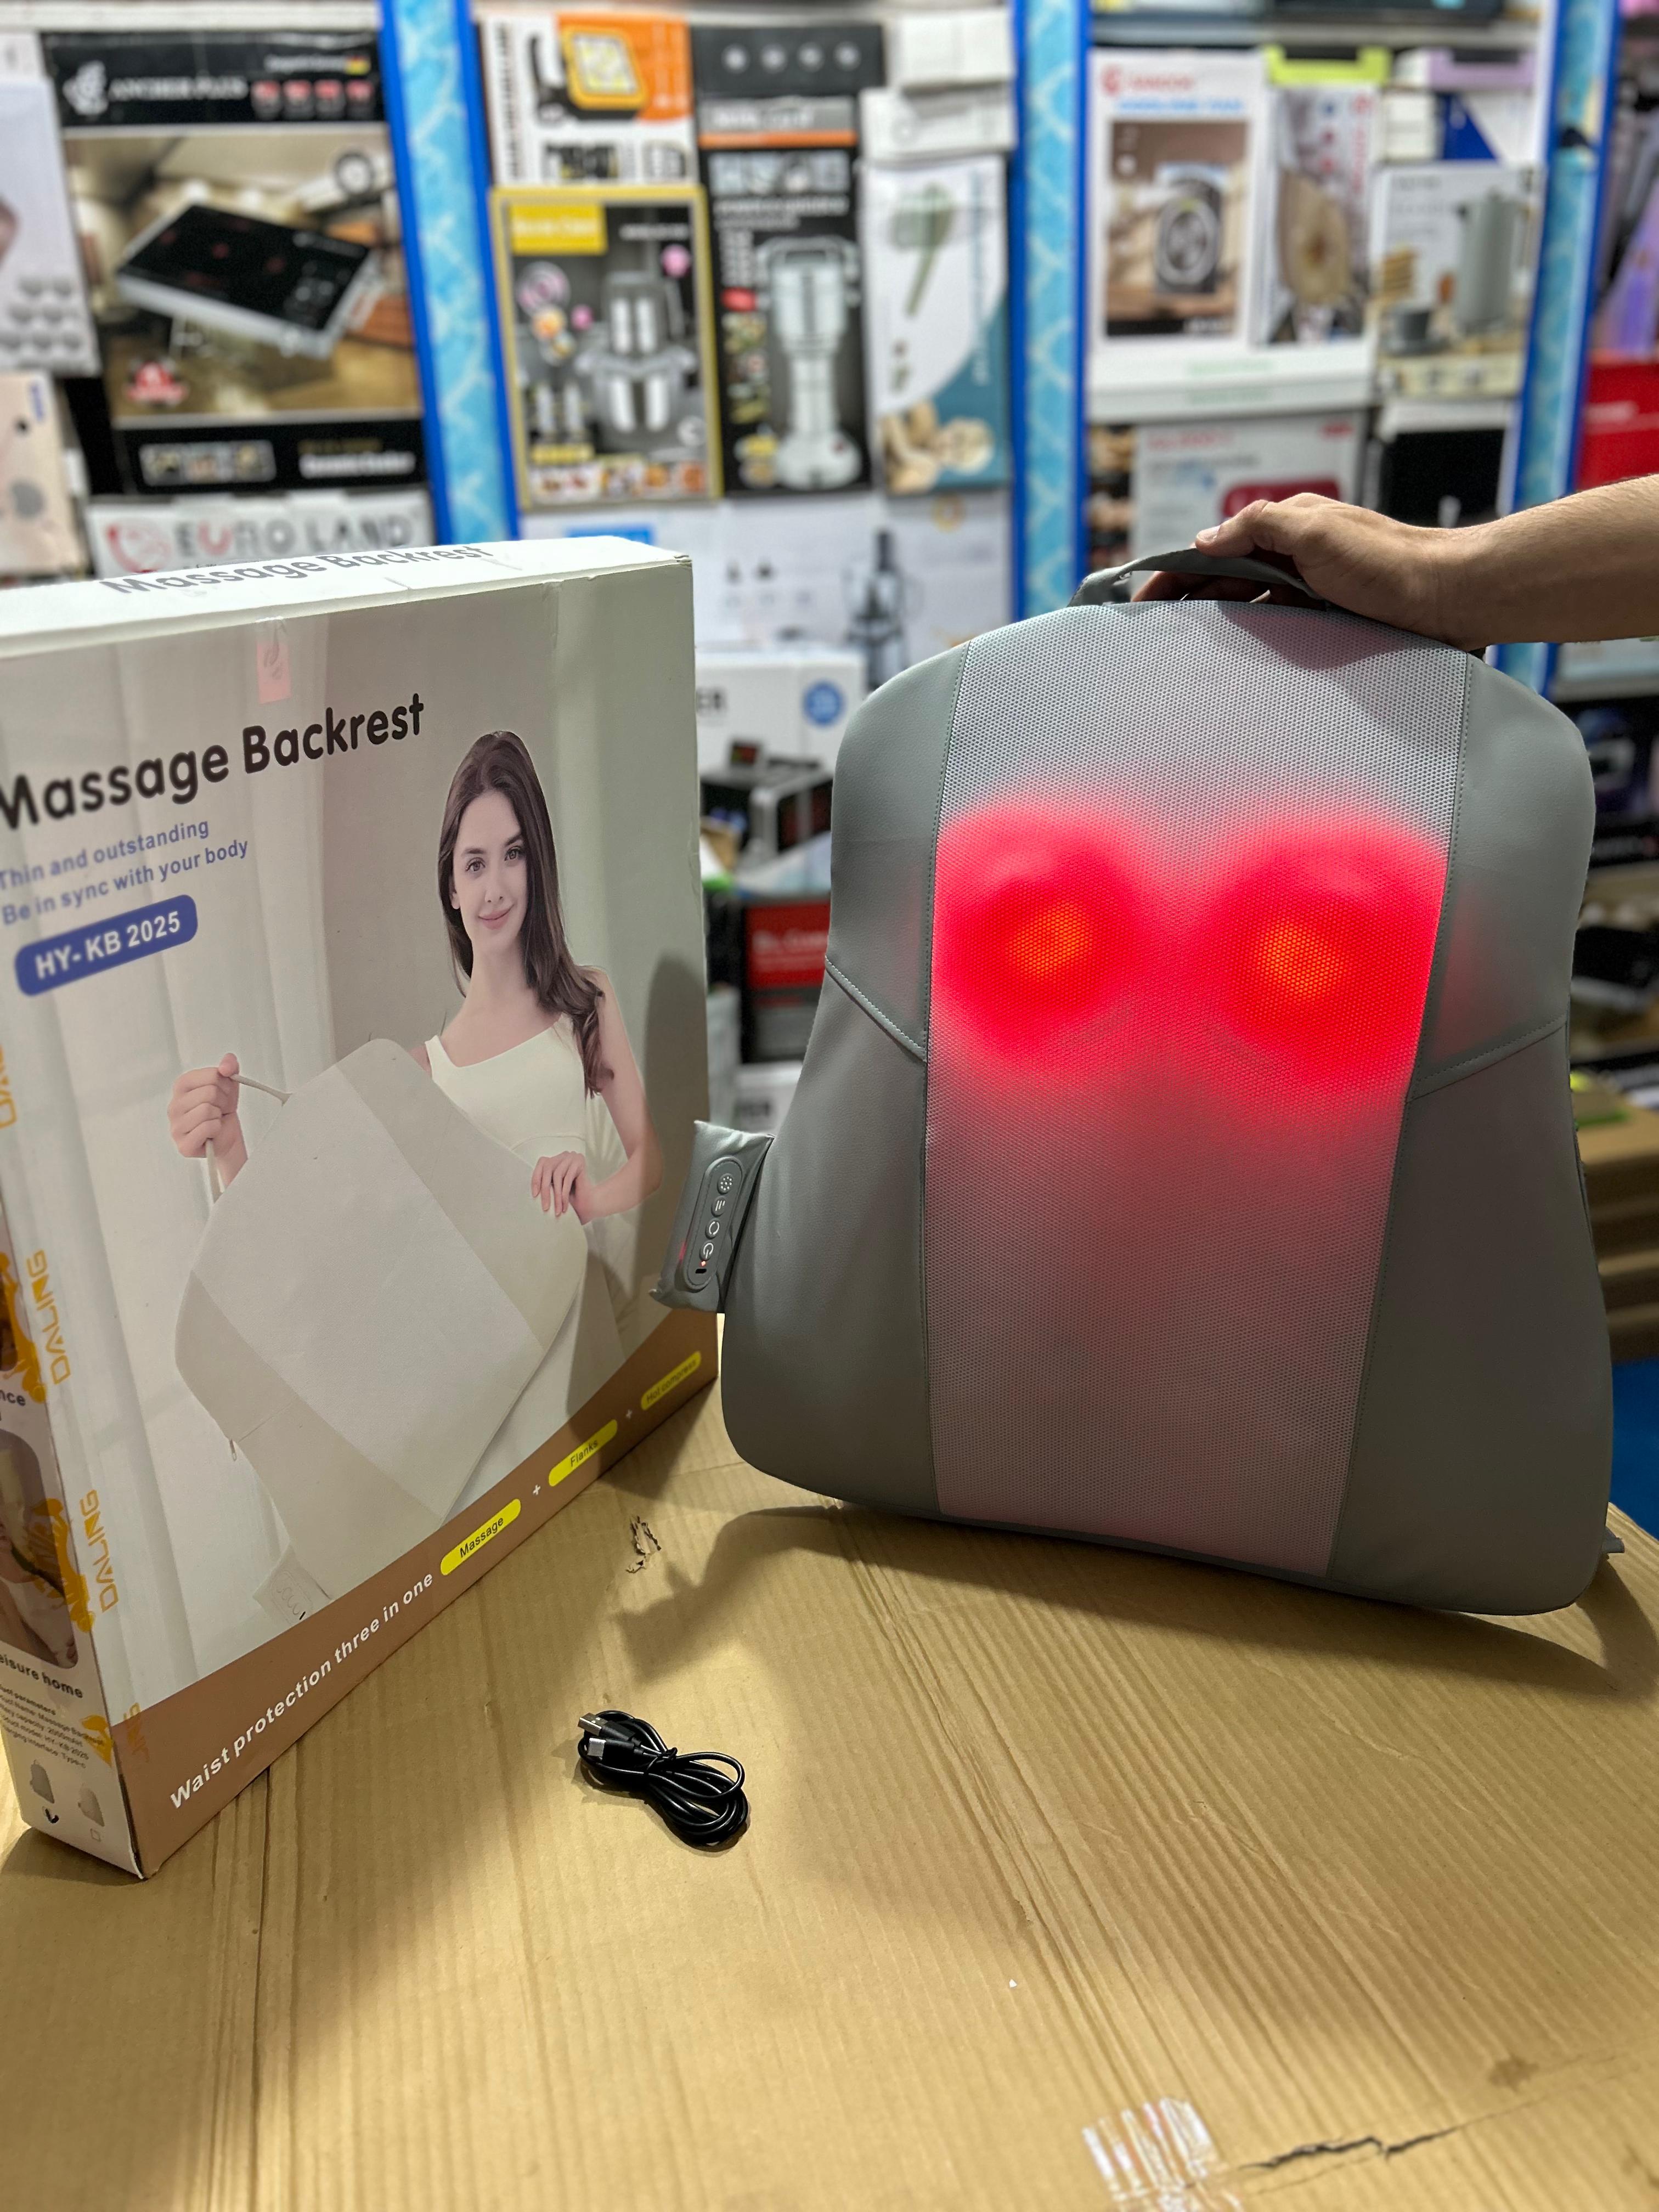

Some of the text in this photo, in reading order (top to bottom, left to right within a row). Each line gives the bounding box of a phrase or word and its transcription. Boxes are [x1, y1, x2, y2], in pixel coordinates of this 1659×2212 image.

[99, 546, 494, 594] Massage Backrest
[0, 693, 424, 830] Massage Backrest
[0, 821, 210, 891] Thin and outstanding
[2, 839, 249, 926] Be in sync with your body
[127, 911, 180, 947] 2025
[460, 1516, 504, 1558] Massage
[571, 1440, 597, 1468] Flanks
[80, 1488, 119, 1613] DALING
[42, 1672, 83, 1699] home
[170, 1573, 433, 1809] Waist protection three in one
